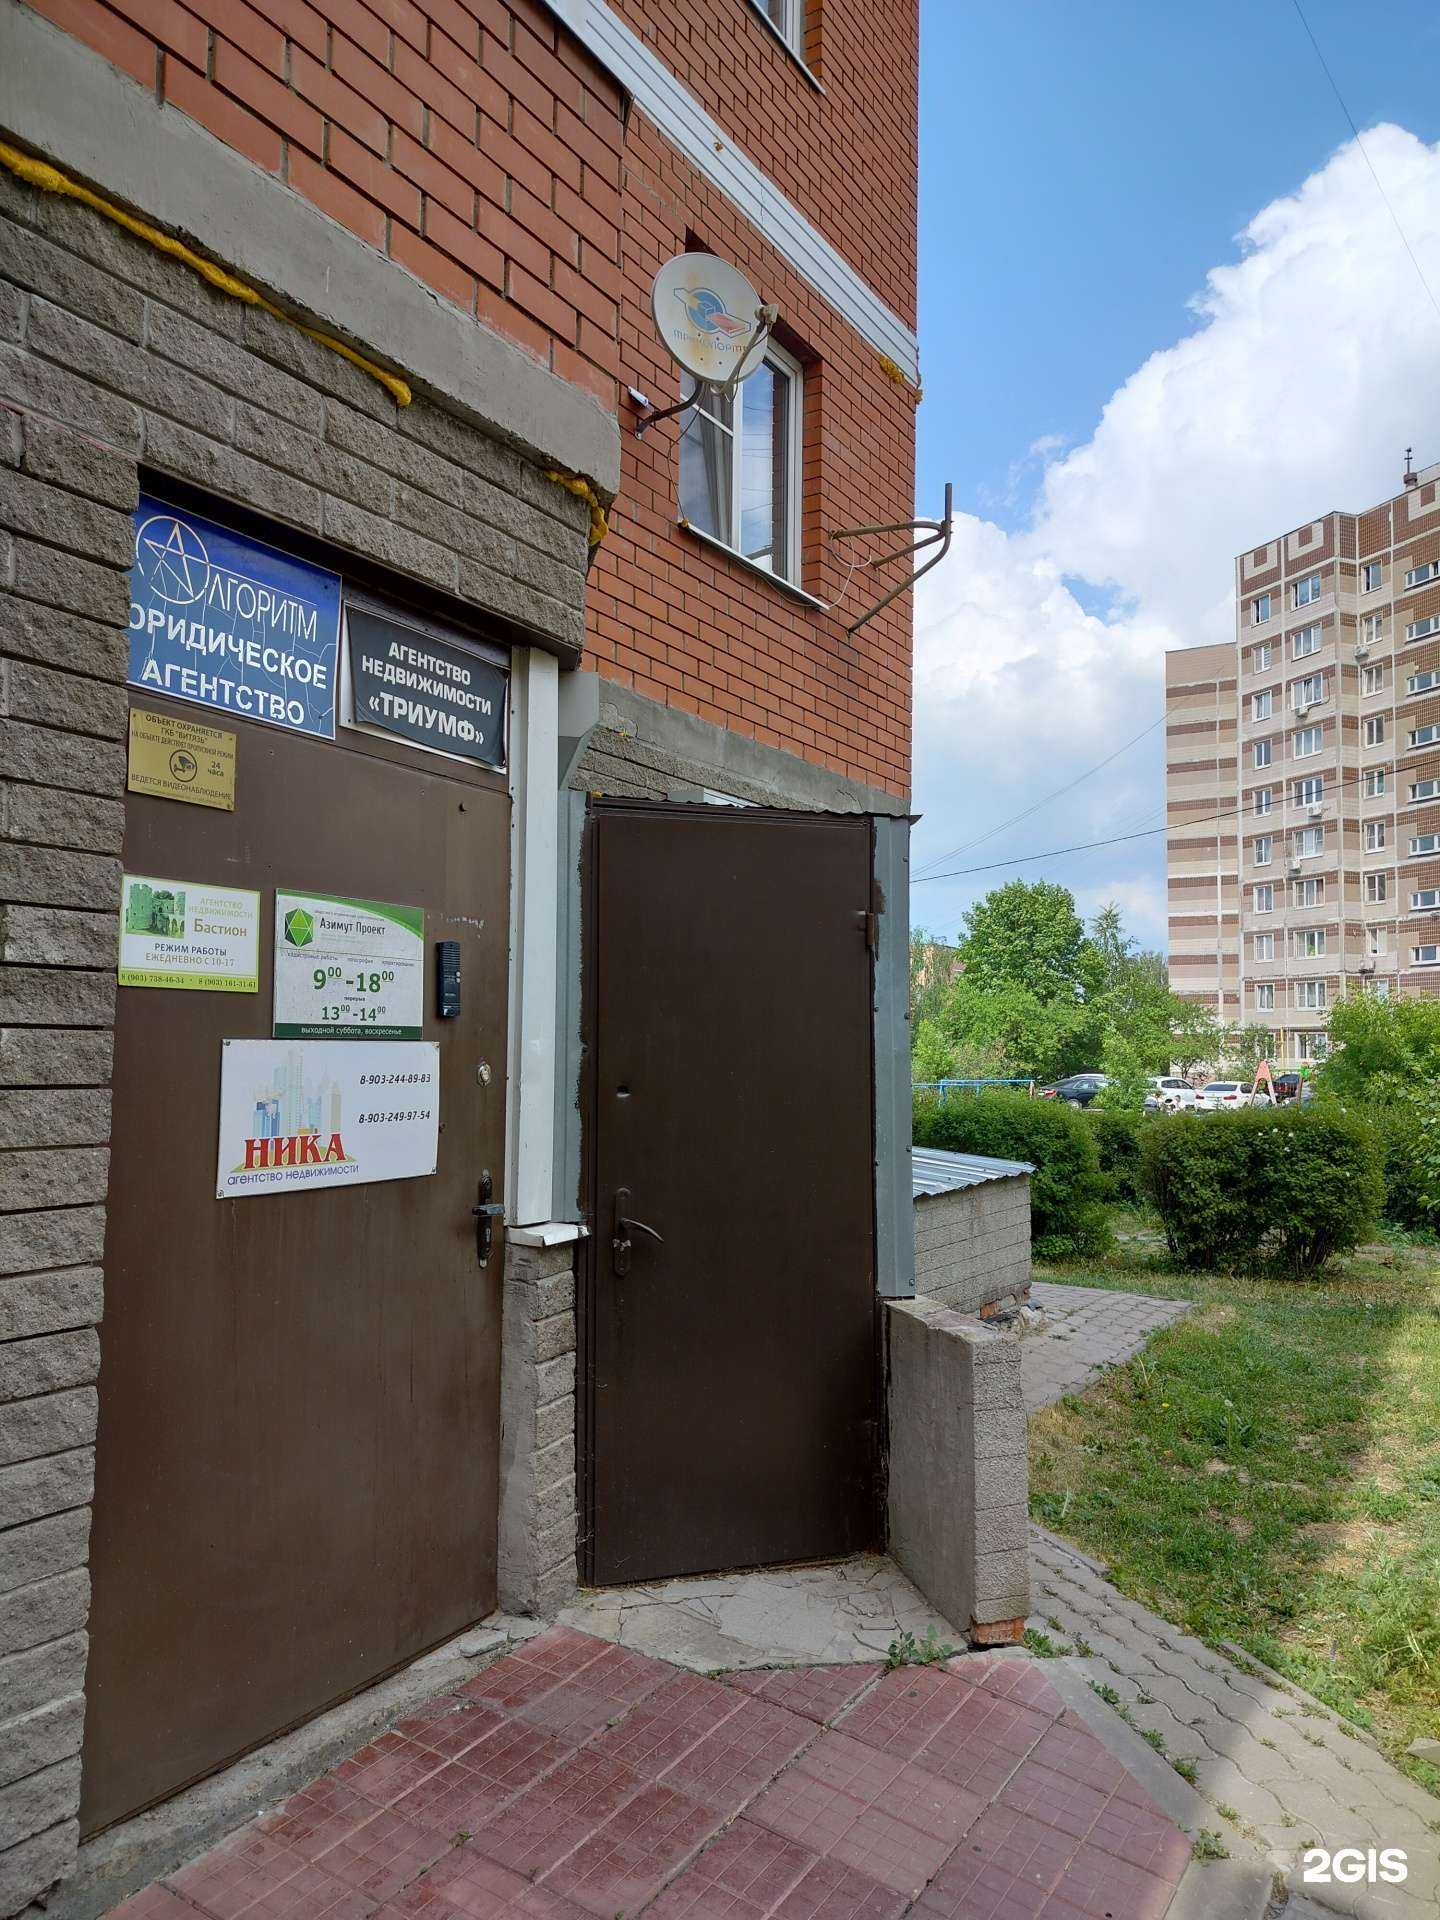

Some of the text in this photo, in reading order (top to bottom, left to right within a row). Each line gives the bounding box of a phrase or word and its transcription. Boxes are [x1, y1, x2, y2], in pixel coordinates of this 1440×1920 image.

[388, 641, 471, 686] АГЕНТСТВО
[141, 658, 305, 725] АГЕНТСТВО
[362, 655, 492, 716] НЕДВИЖИМОСТИ
[145, 714, 223, 739] ОБЪЕКТ ОХРАНЯЕТСЯ
[368, 691, 485, 745] «ТРИУМФ»
[211, 760, 221, 769] 24
[131, 774, 161, 786] ВЕДЕТСЯ
[162, 780, 232, 801] ВИДЕОНАБЛЮДЕНИЕ
[194, 918, 247, 937] Бастион
[319, 917, 386, 936] Азимут Проект
[145, 952, 202, 965] ЕЖЕДНЕВНО
[154, 942, 227, 956] РЕЖИМ РАБОТЫ
[301, 1026, 335, 1035] выходной
[365, 1028, 402, 1036] воскресенье
[359, 1073, 431, 1085] 8-903-244-89-83
[358, 1110, 431, 1124] 8-903-249-97-54
[243, 1133, 347, 1170] НИКА
[227, 1164, 359, 1186] агентство недвижимости
